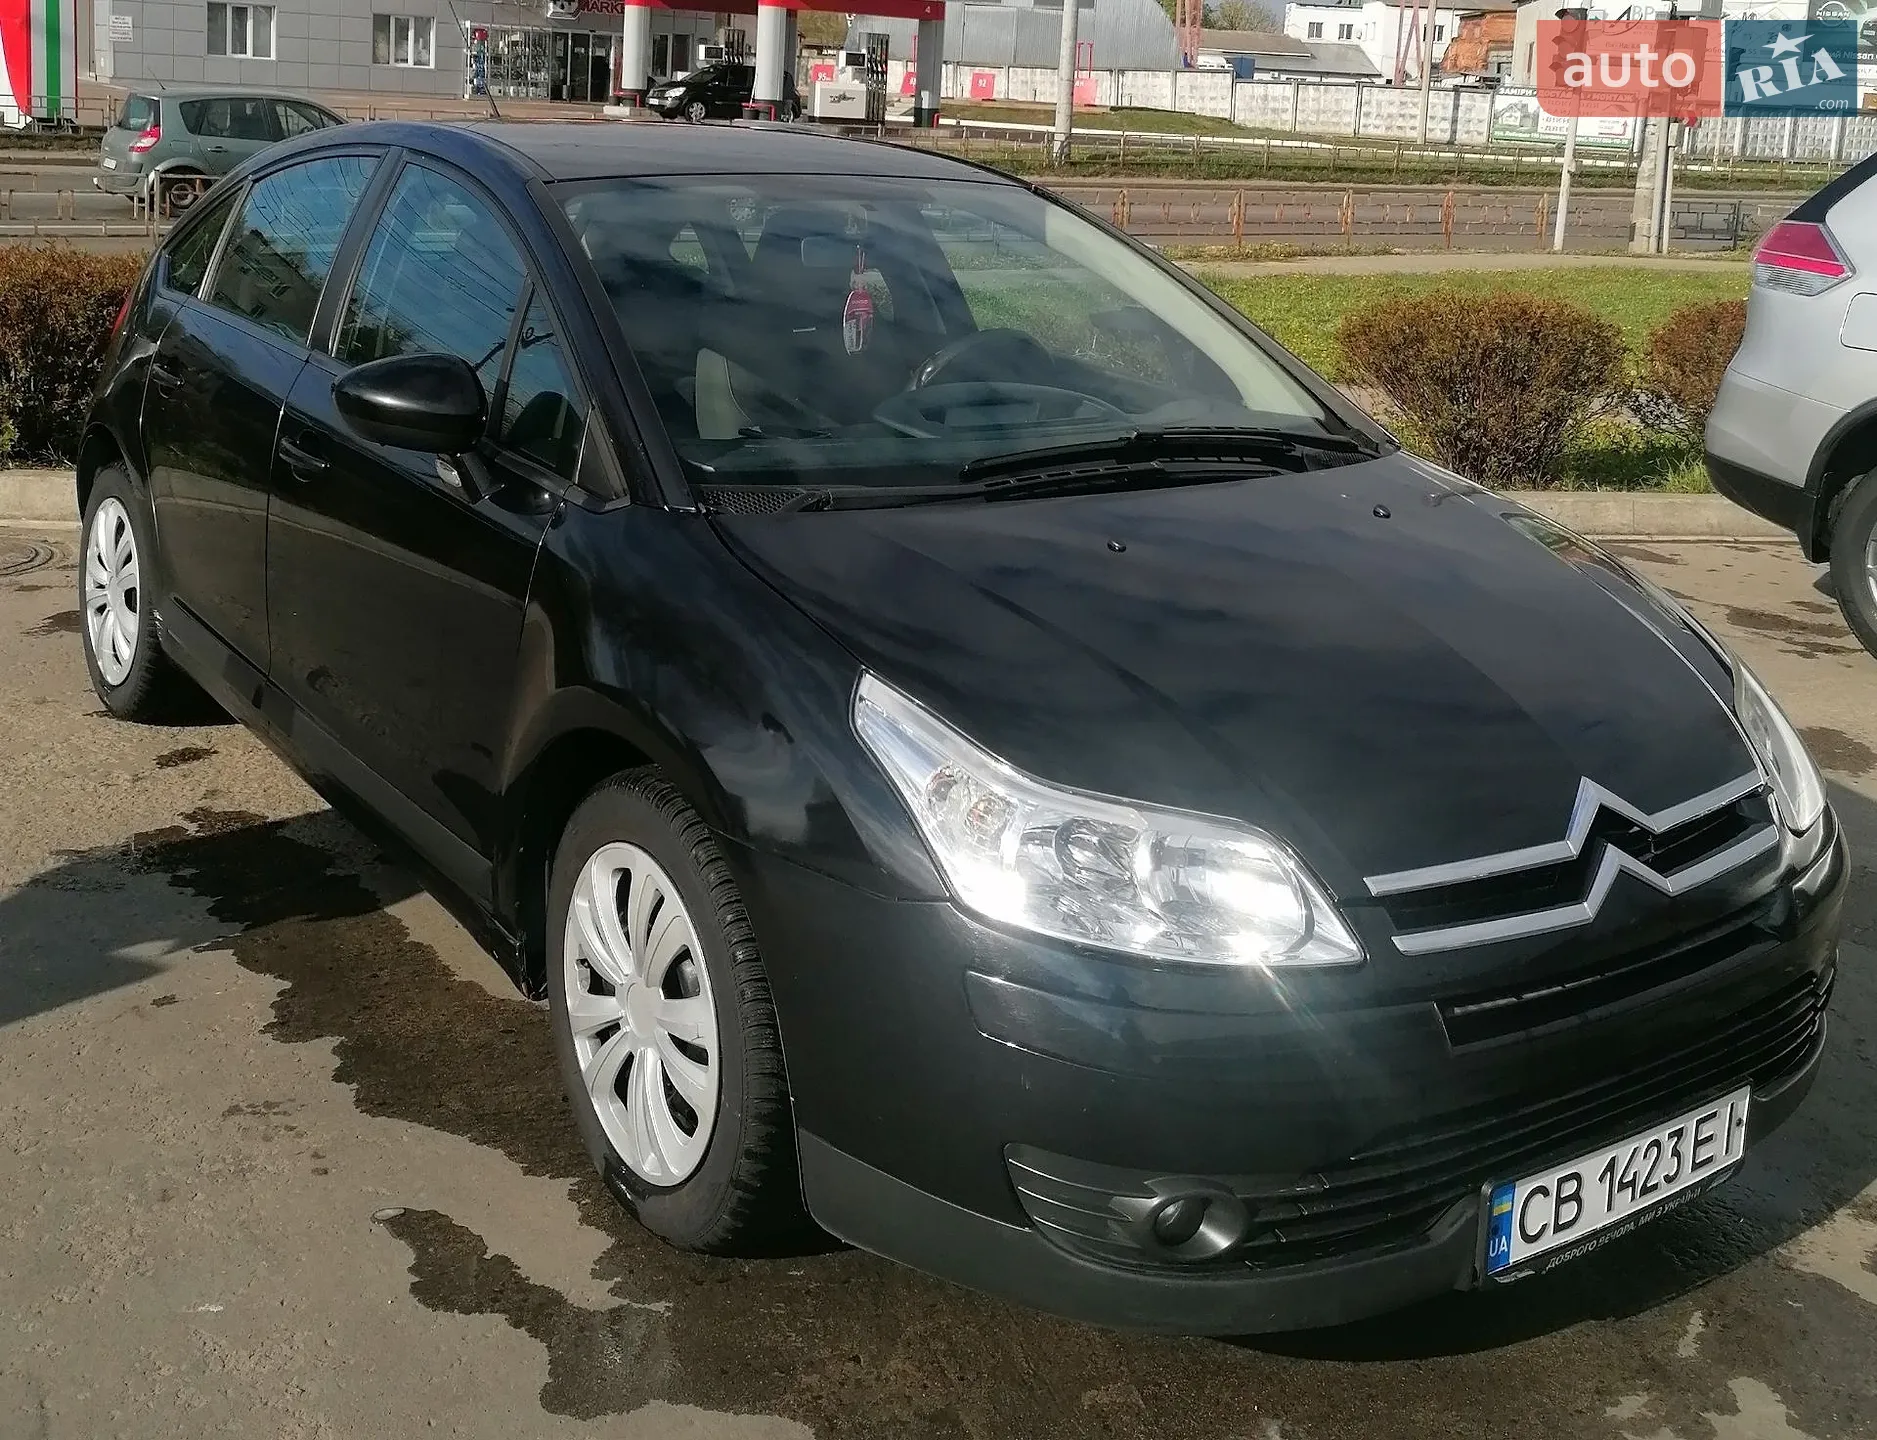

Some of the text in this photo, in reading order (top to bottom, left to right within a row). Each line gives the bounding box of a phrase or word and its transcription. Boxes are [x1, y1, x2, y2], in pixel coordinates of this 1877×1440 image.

[1518, 1171, 1583, 1244] CB
[1598, 1124, 1686, 1212] 1423
[1489, 1235, 1508, 1257] UA
